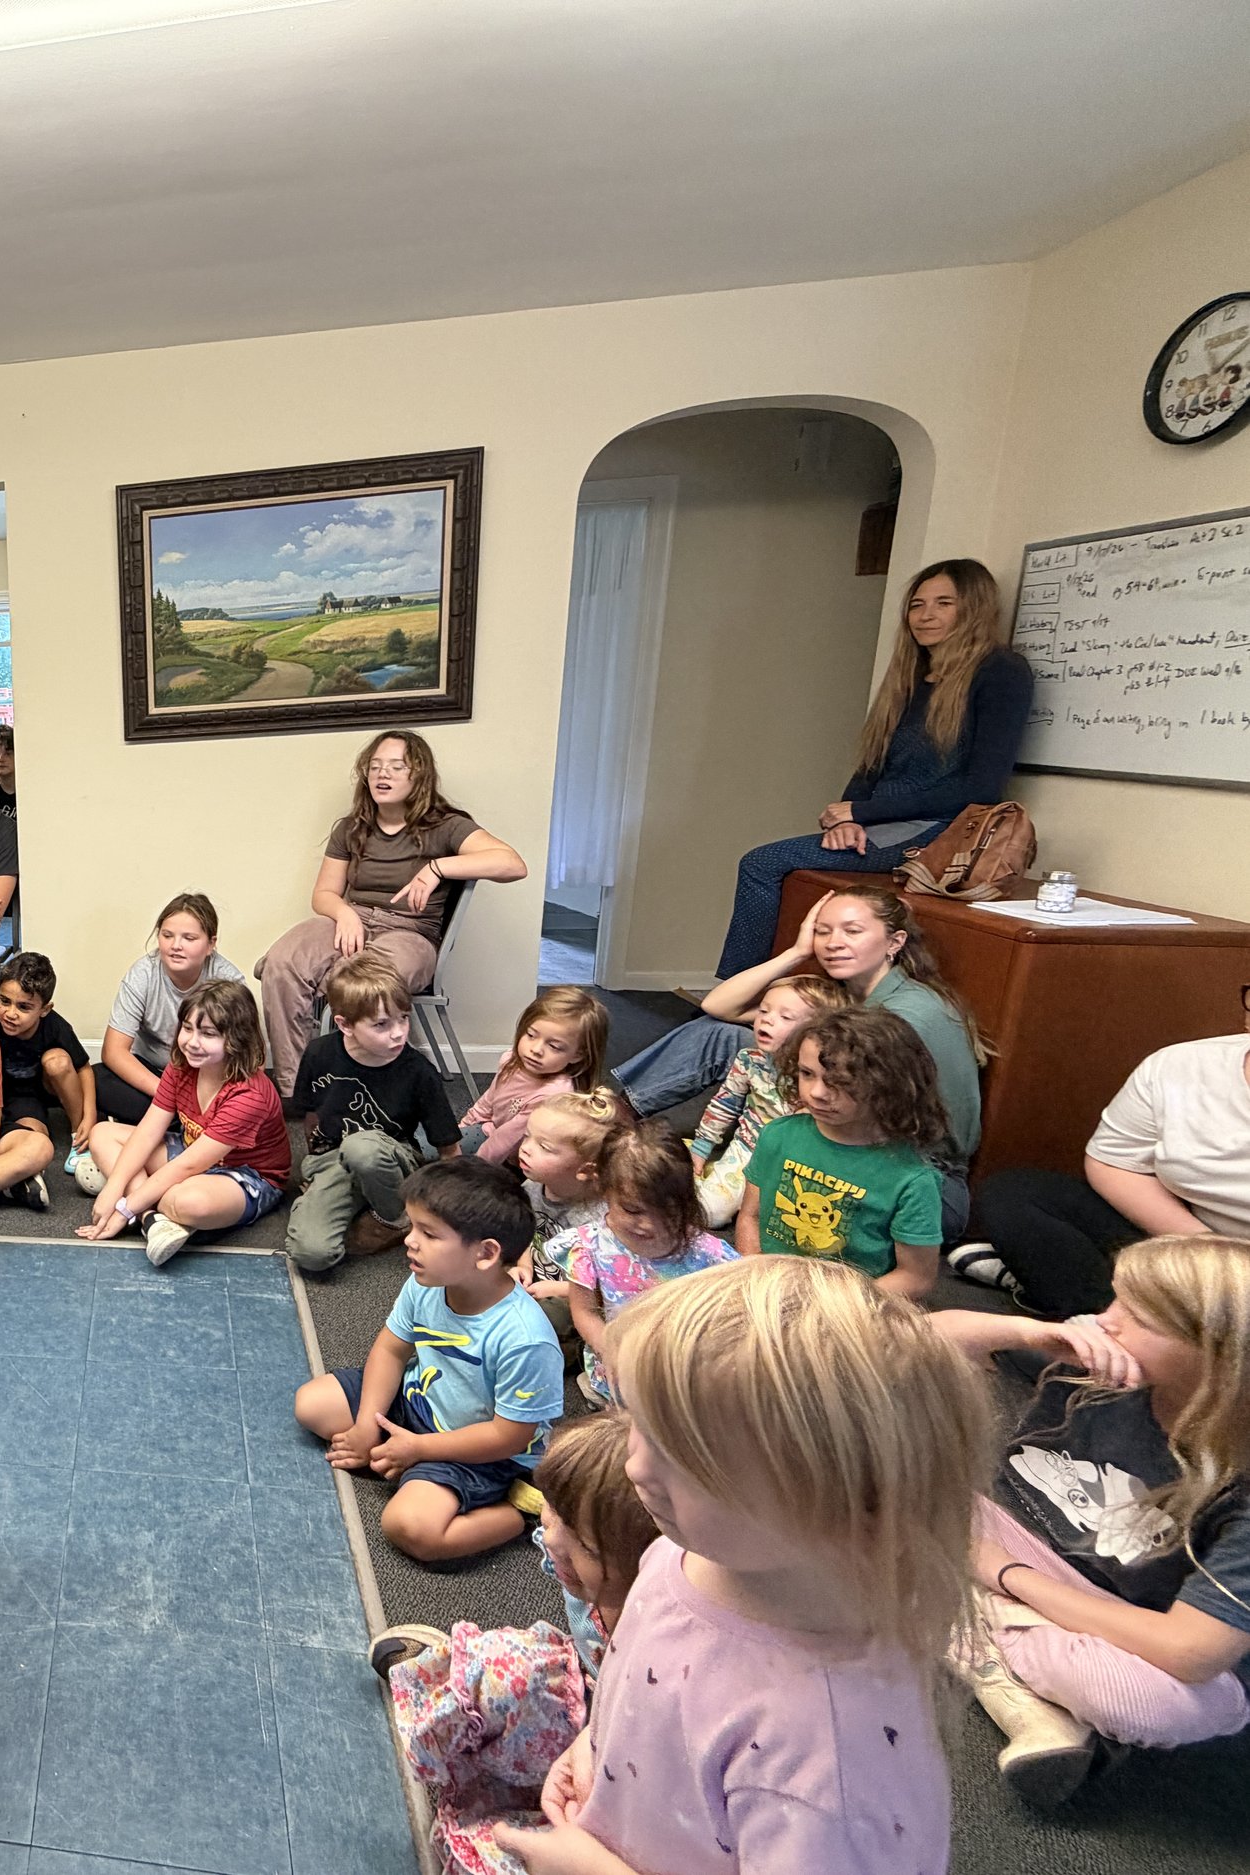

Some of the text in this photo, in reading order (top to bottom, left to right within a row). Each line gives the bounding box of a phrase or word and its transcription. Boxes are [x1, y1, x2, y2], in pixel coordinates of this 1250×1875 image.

[1223, 304, 1237, 321] 12
[1198, 322, 1208, 338] 11
[1175, 349, 1189, 365] 10
[1165, 379, 1174, 393] 9
[1165, 404, 1175, 418] 8
[1179, 419, 1189, 433] 7
[1201, 420, 1212, 433] 6
[1064, 619, 1091, 632] TEST
[1116, 664, 1124, 676] 3
[783, 1158, 867, 1200] PIKACHU
